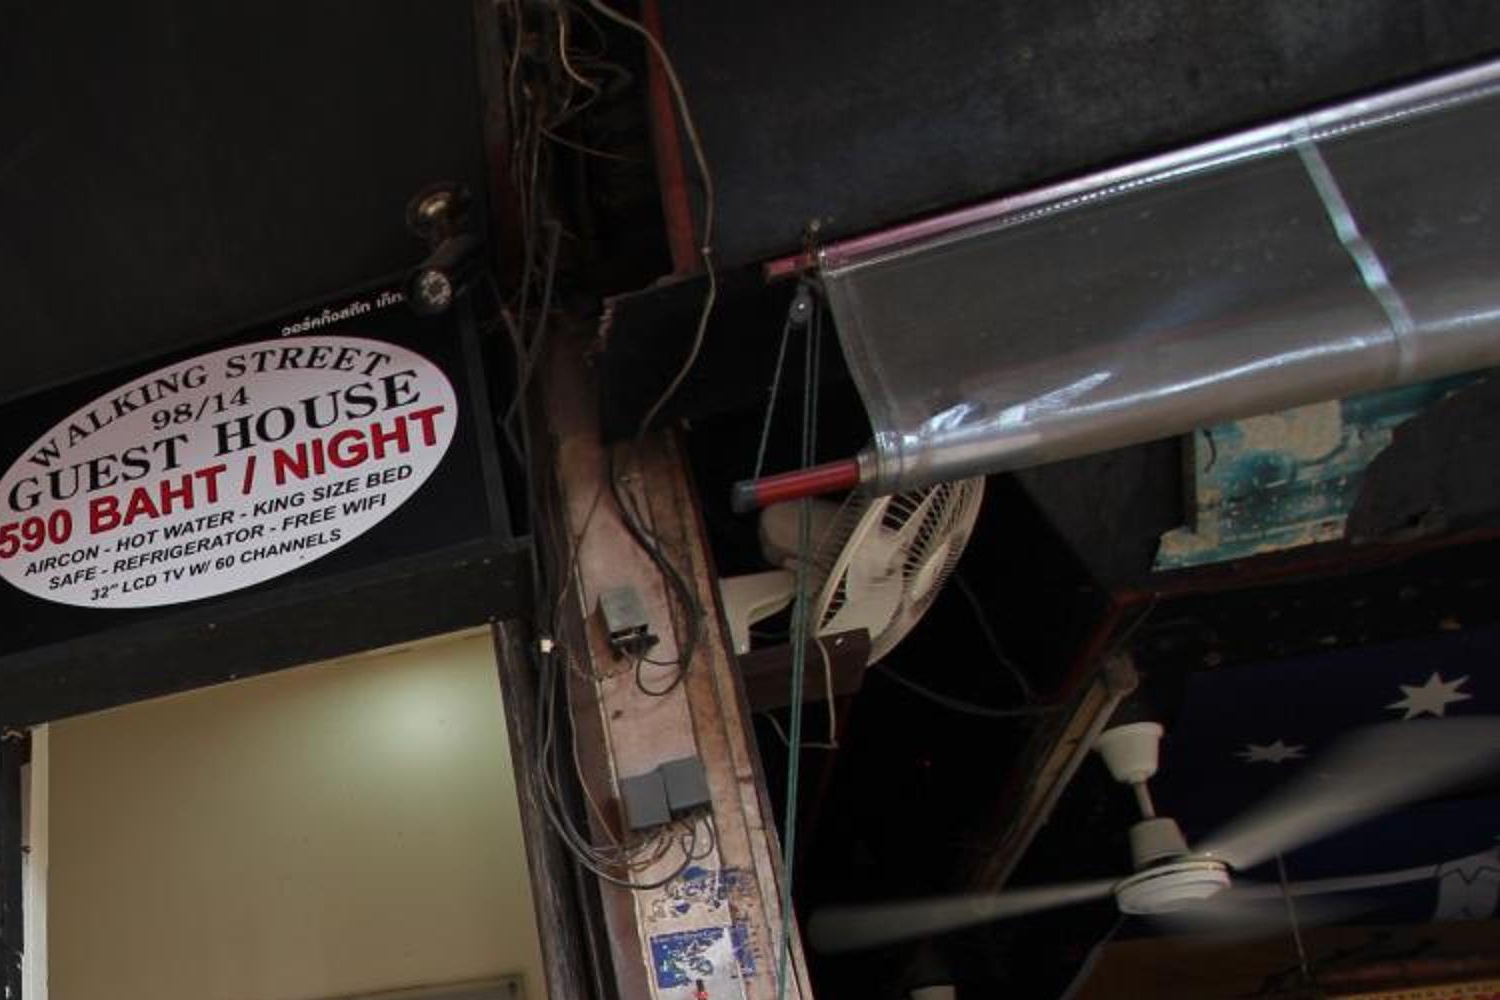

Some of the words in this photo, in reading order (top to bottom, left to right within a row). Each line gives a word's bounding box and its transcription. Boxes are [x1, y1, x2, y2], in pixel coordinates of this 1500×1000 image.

[8, 434, 190, 514] GUEST
[214, 368, 423, 458] HOUSE
[29, 365, 208, 468] WALKING
[225, 344, 393, 381] STREET
[151, 386, 251, 432] 98/14
[25, 544, 100, 577] AIRCON
[116, 531, 160, 555] HOT
[164, 510, 235, 544] WATER
[253, 493, 306, 519] KING
[312, 478, 361, 503] SIZE
[365, 464, 414, 492] BED
[88, 462, 227, 536] BAHT
[273, 405, 447, 486] NIGHT
[48, 565, 97, 591] SAFE
[112, 525, 265, 573] REFRIGERATOR
[282, 507, 338, 533] FREE
[342, 493, 388, 518] WIFI
[122, 574, 158, 594] LCD
[163, 567, 186, 586] TV
[215, 553, 235, 572] 60
[240, 527, 342, 566] CHANNELS
